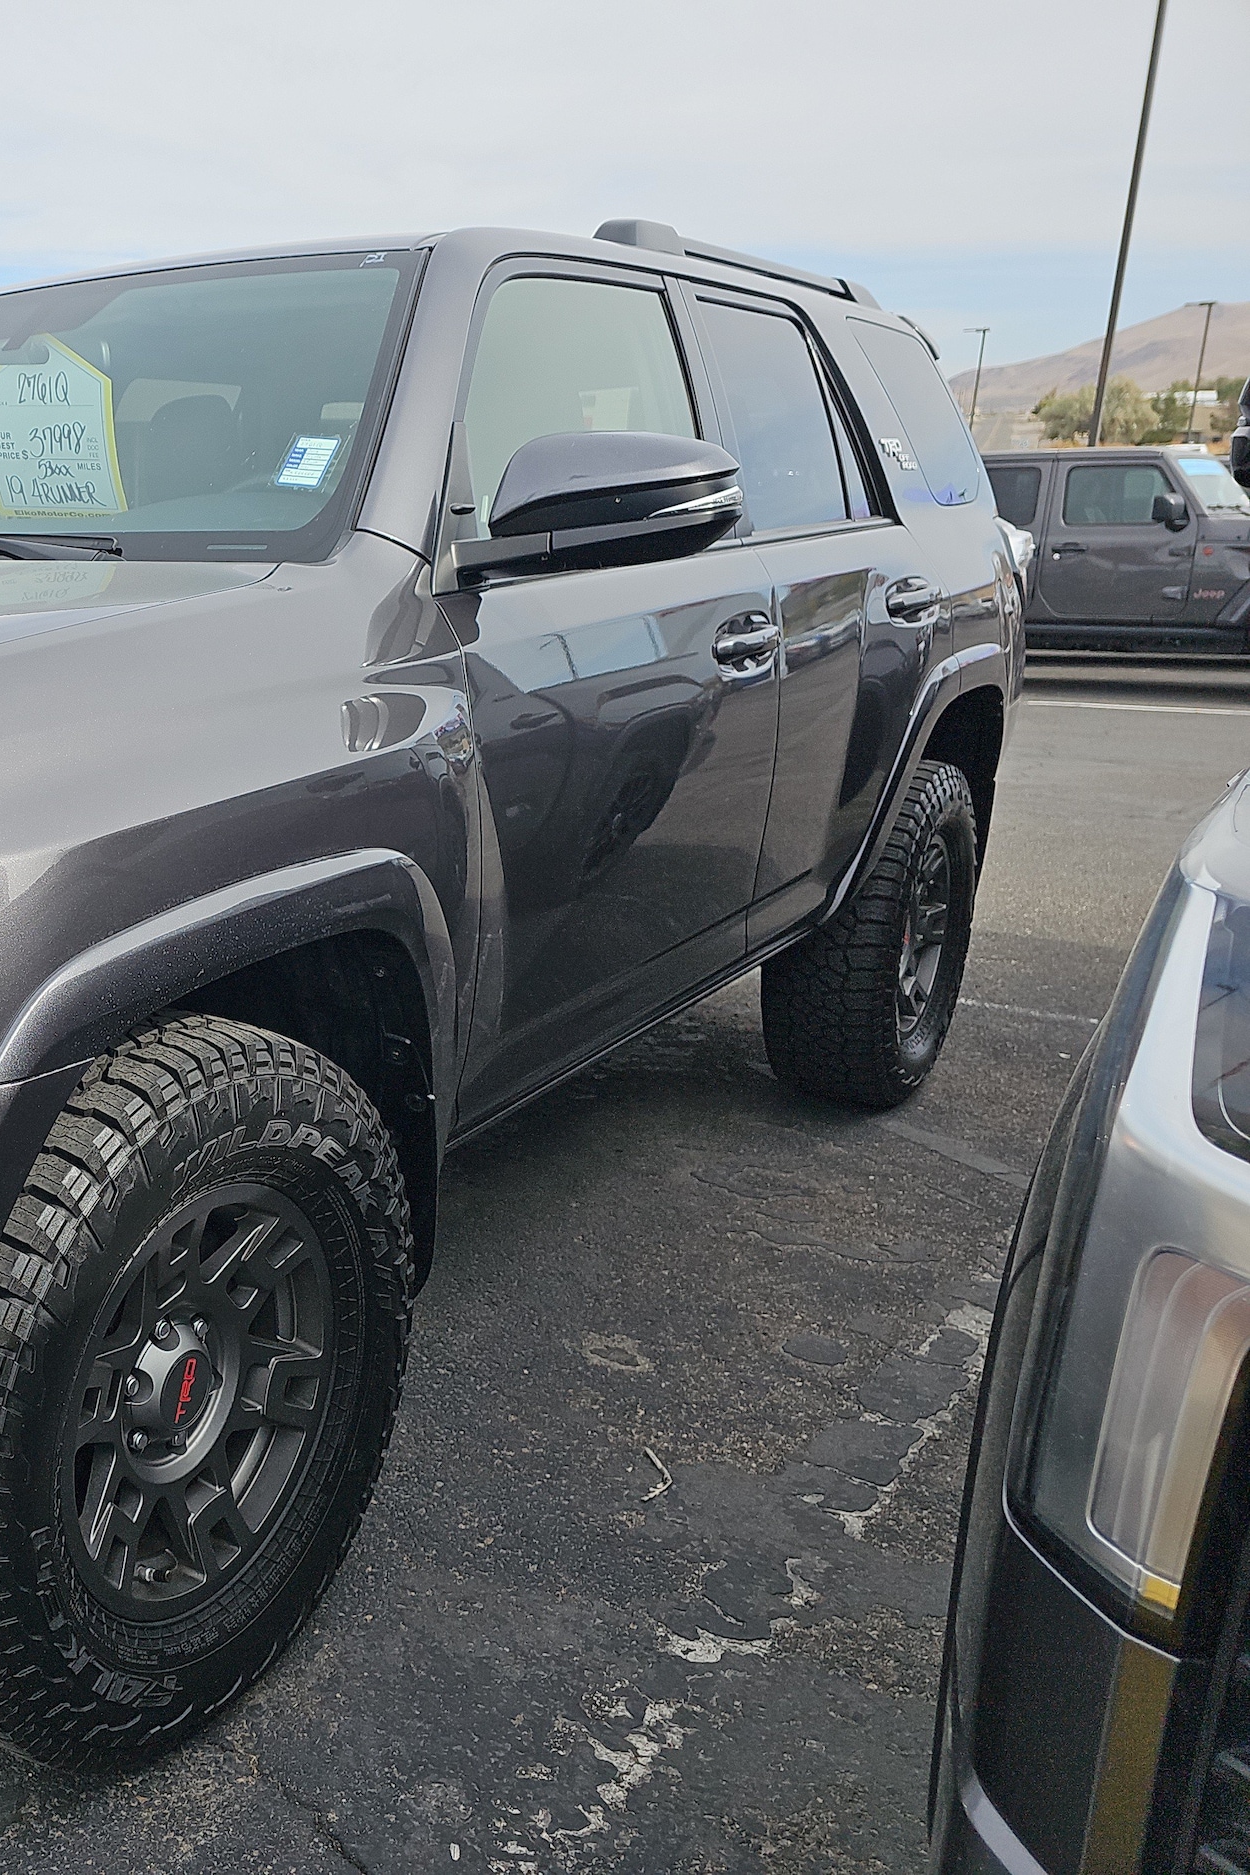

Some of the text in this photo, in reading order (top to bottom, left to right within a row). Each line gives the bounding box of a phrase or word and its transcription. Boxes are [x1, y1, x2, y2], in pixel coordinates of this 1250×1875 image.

[29, 421, 87, 458] 37998
[879, 438, 902, 457] TRD
[21, 450, 29, 460] $
[77, 462, 102, 471] MILES
[5, 475, 107, 507] 19 4RUNNER
[1193, 588, 1225, 600] Jeep
[174, 1357, 197, 1424] TRD
